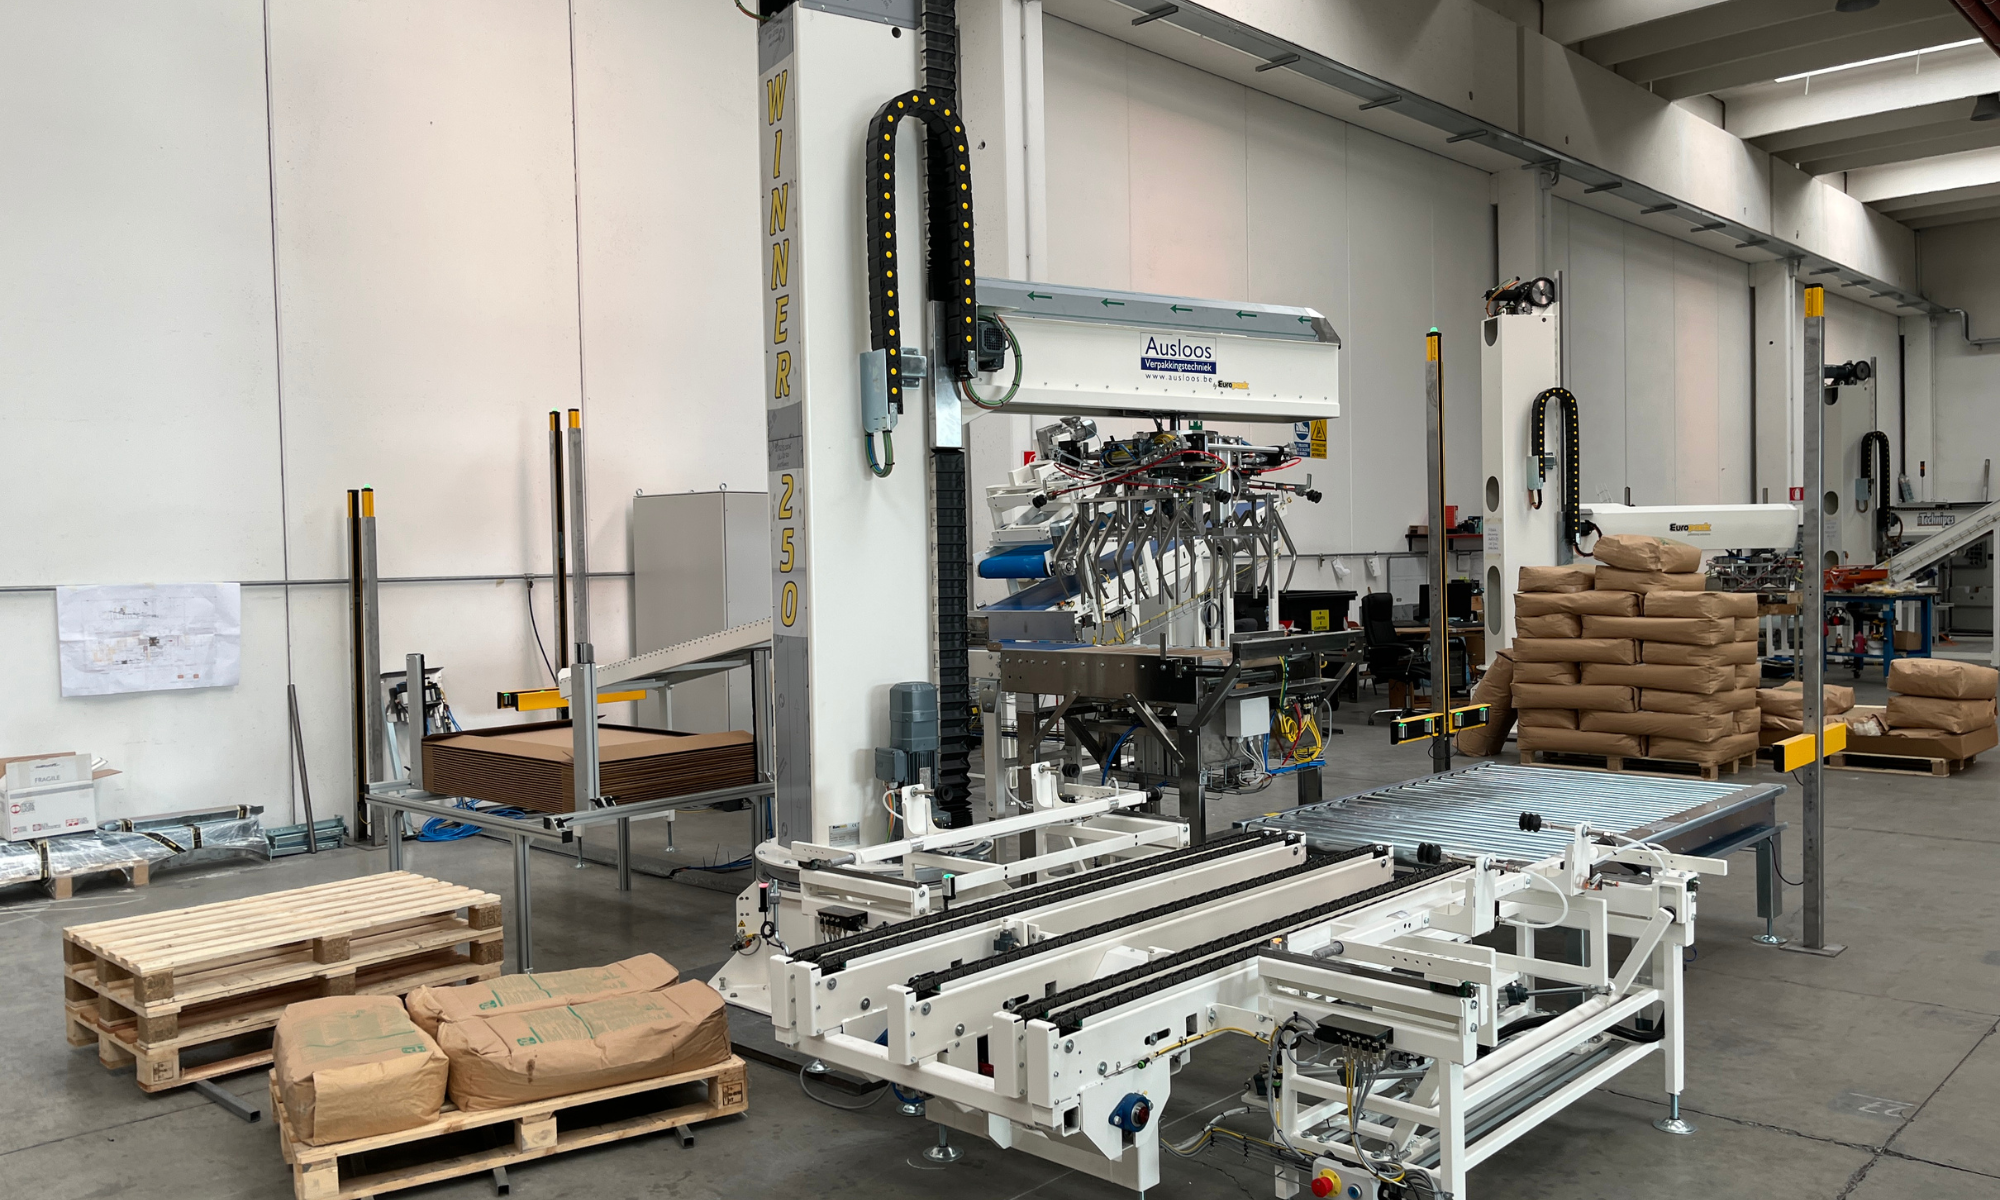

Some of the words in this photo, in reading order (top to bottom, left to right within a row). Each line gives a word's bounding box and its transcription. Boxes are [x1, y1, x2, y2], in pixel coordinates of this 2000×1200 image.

[767, 69, 791, 400] WINNER
[779, 473, 798, 627] 250
[1145, 336, 1212, 359] Ausloos
[1145, 359, 1212, 372] Verpakkingstechniek
[1145, 373, 1213, 383] www.ausloos.be
[34, 775, 60, 784] FRAGILE
